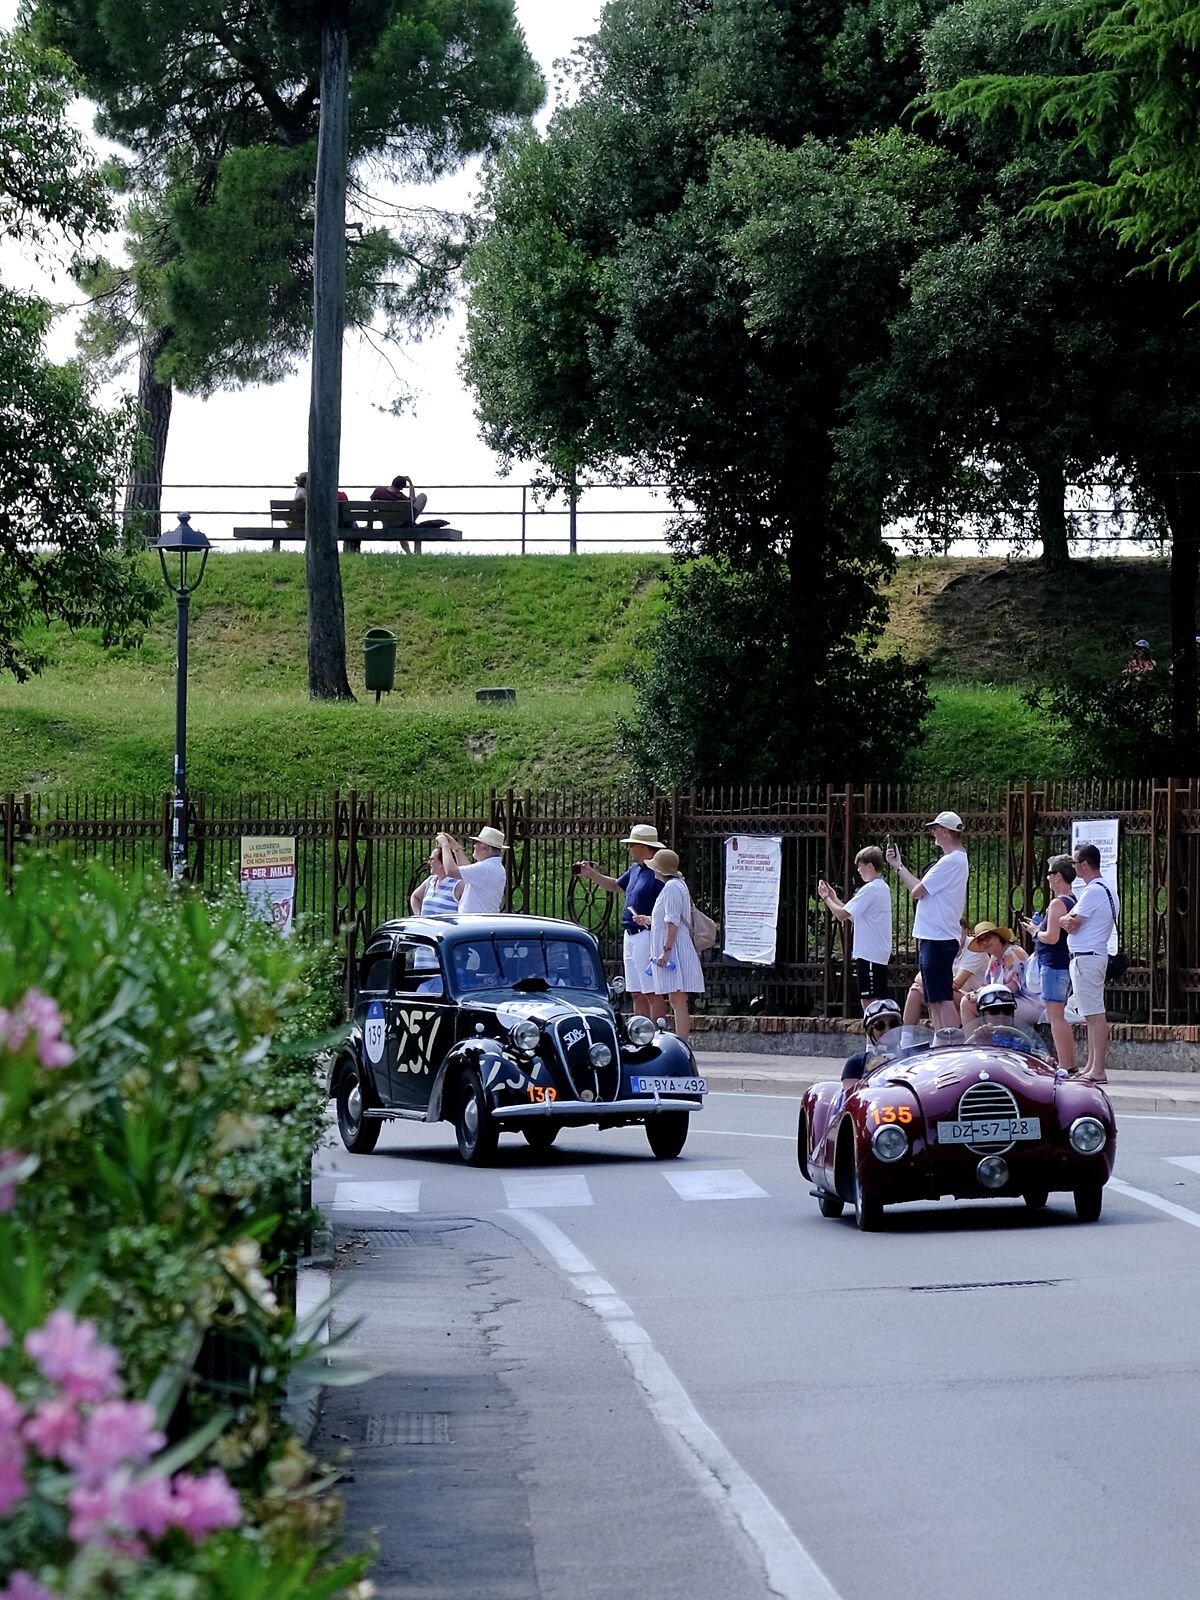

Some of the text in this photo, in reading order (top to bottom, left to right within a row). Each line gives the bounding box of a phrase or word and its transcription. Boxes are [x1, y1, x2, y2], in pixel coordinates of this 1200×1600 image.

[252, 868, 267, 878] PER
[270, 866, 292, 877] MILLE
[368, 1025, 382, 1045] 139
[526, 1086, 557, 1103] 139
[871, 1106, 912, 1125] 135
[952, 1121, 1029, 1139] DZ-57-28
